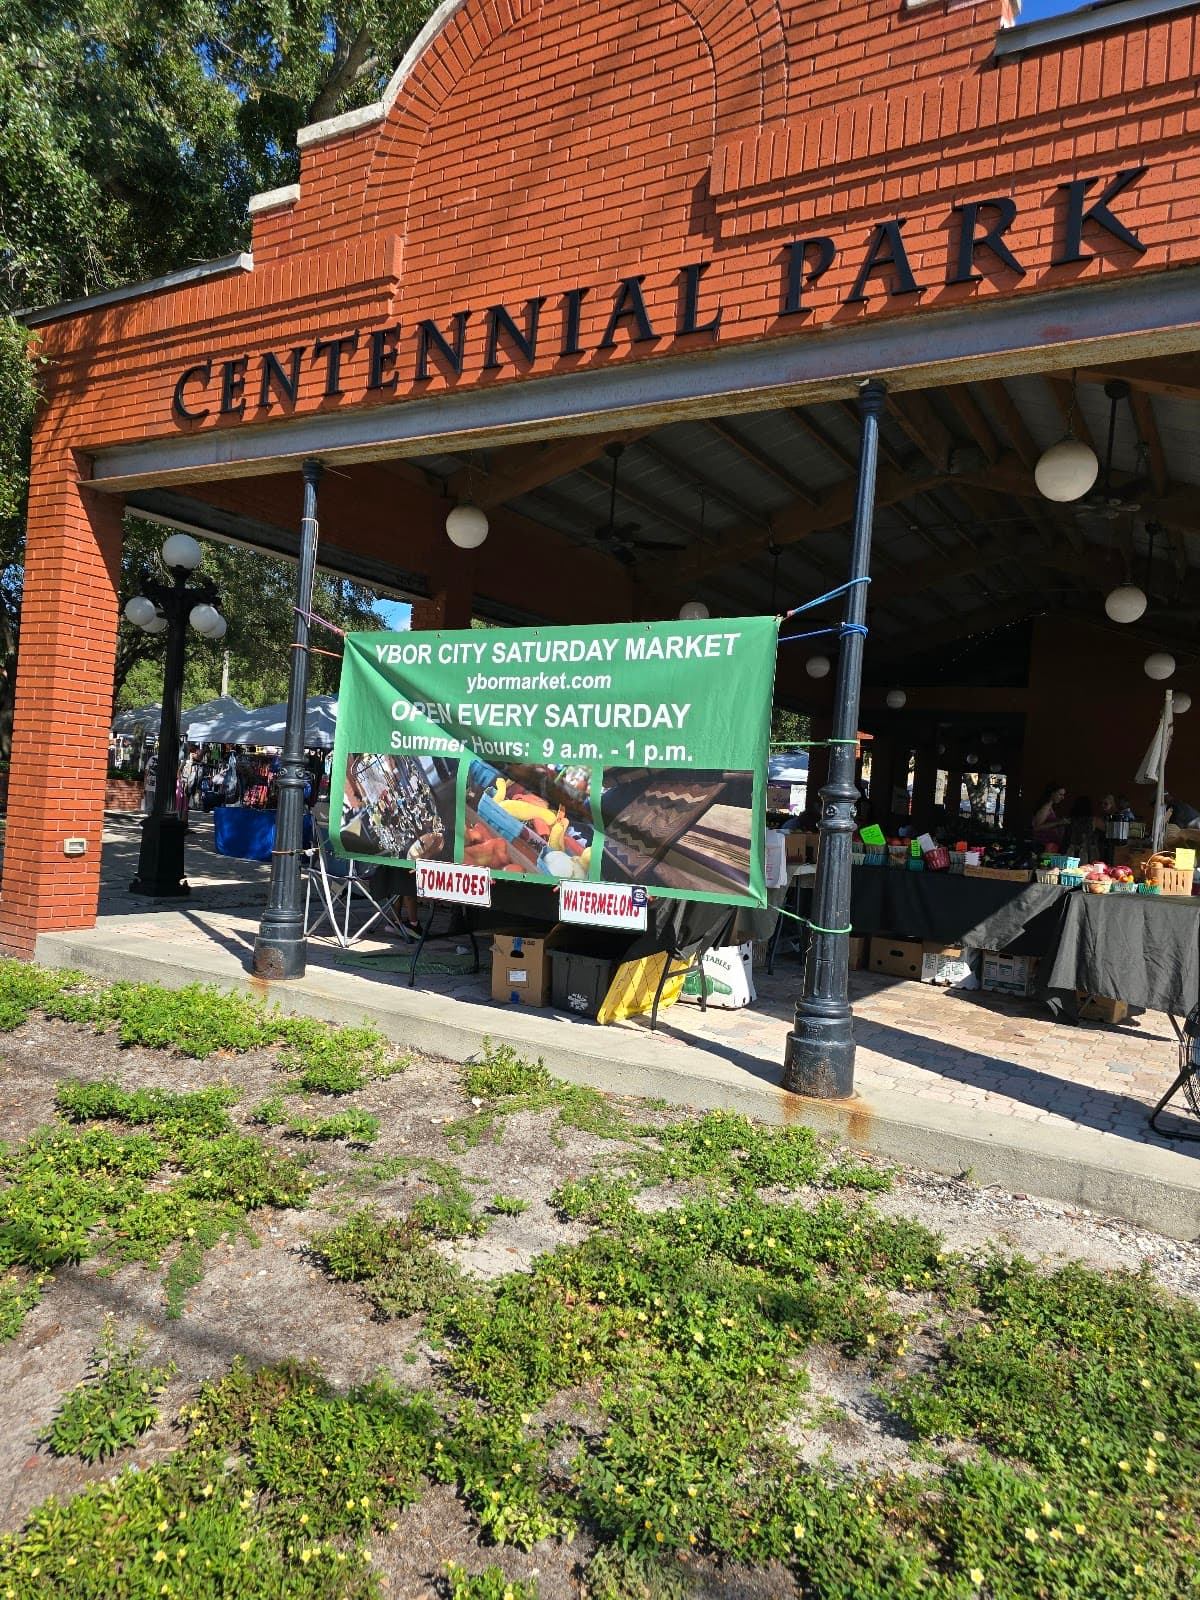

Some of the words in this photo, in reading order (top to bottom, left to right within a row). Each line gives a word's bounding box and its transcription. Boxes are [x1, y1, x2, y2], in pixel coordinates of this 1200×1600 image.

[173, 261, 721, 420] CENTENNIAL
[778, 165, 1149, 316] PARK
[375, 644, 432, 664] YBOR
[438, 642, 487, 664] CITY
[491, 638, 619, 664] SATURDAY
[625, 633, 742, 661] MARKET
[466, 672, 611, 694] ybormarket.com
[391, 700, 453, 724] OPEN
[458, 703, 539, 727] EVERY
[544, 703, 692, 728] SATURDAY
[390, 731, 468, 753] Summer
[471, 735, 530, 757] Hours:
[542, 738, 554, 758] 9
[560, 741, 603, 759] a.m.
[625, 739, 635, 760] 1
[644, 743, 693, 765] p.m.
[420, 868, 486, 896] TOMATOES
